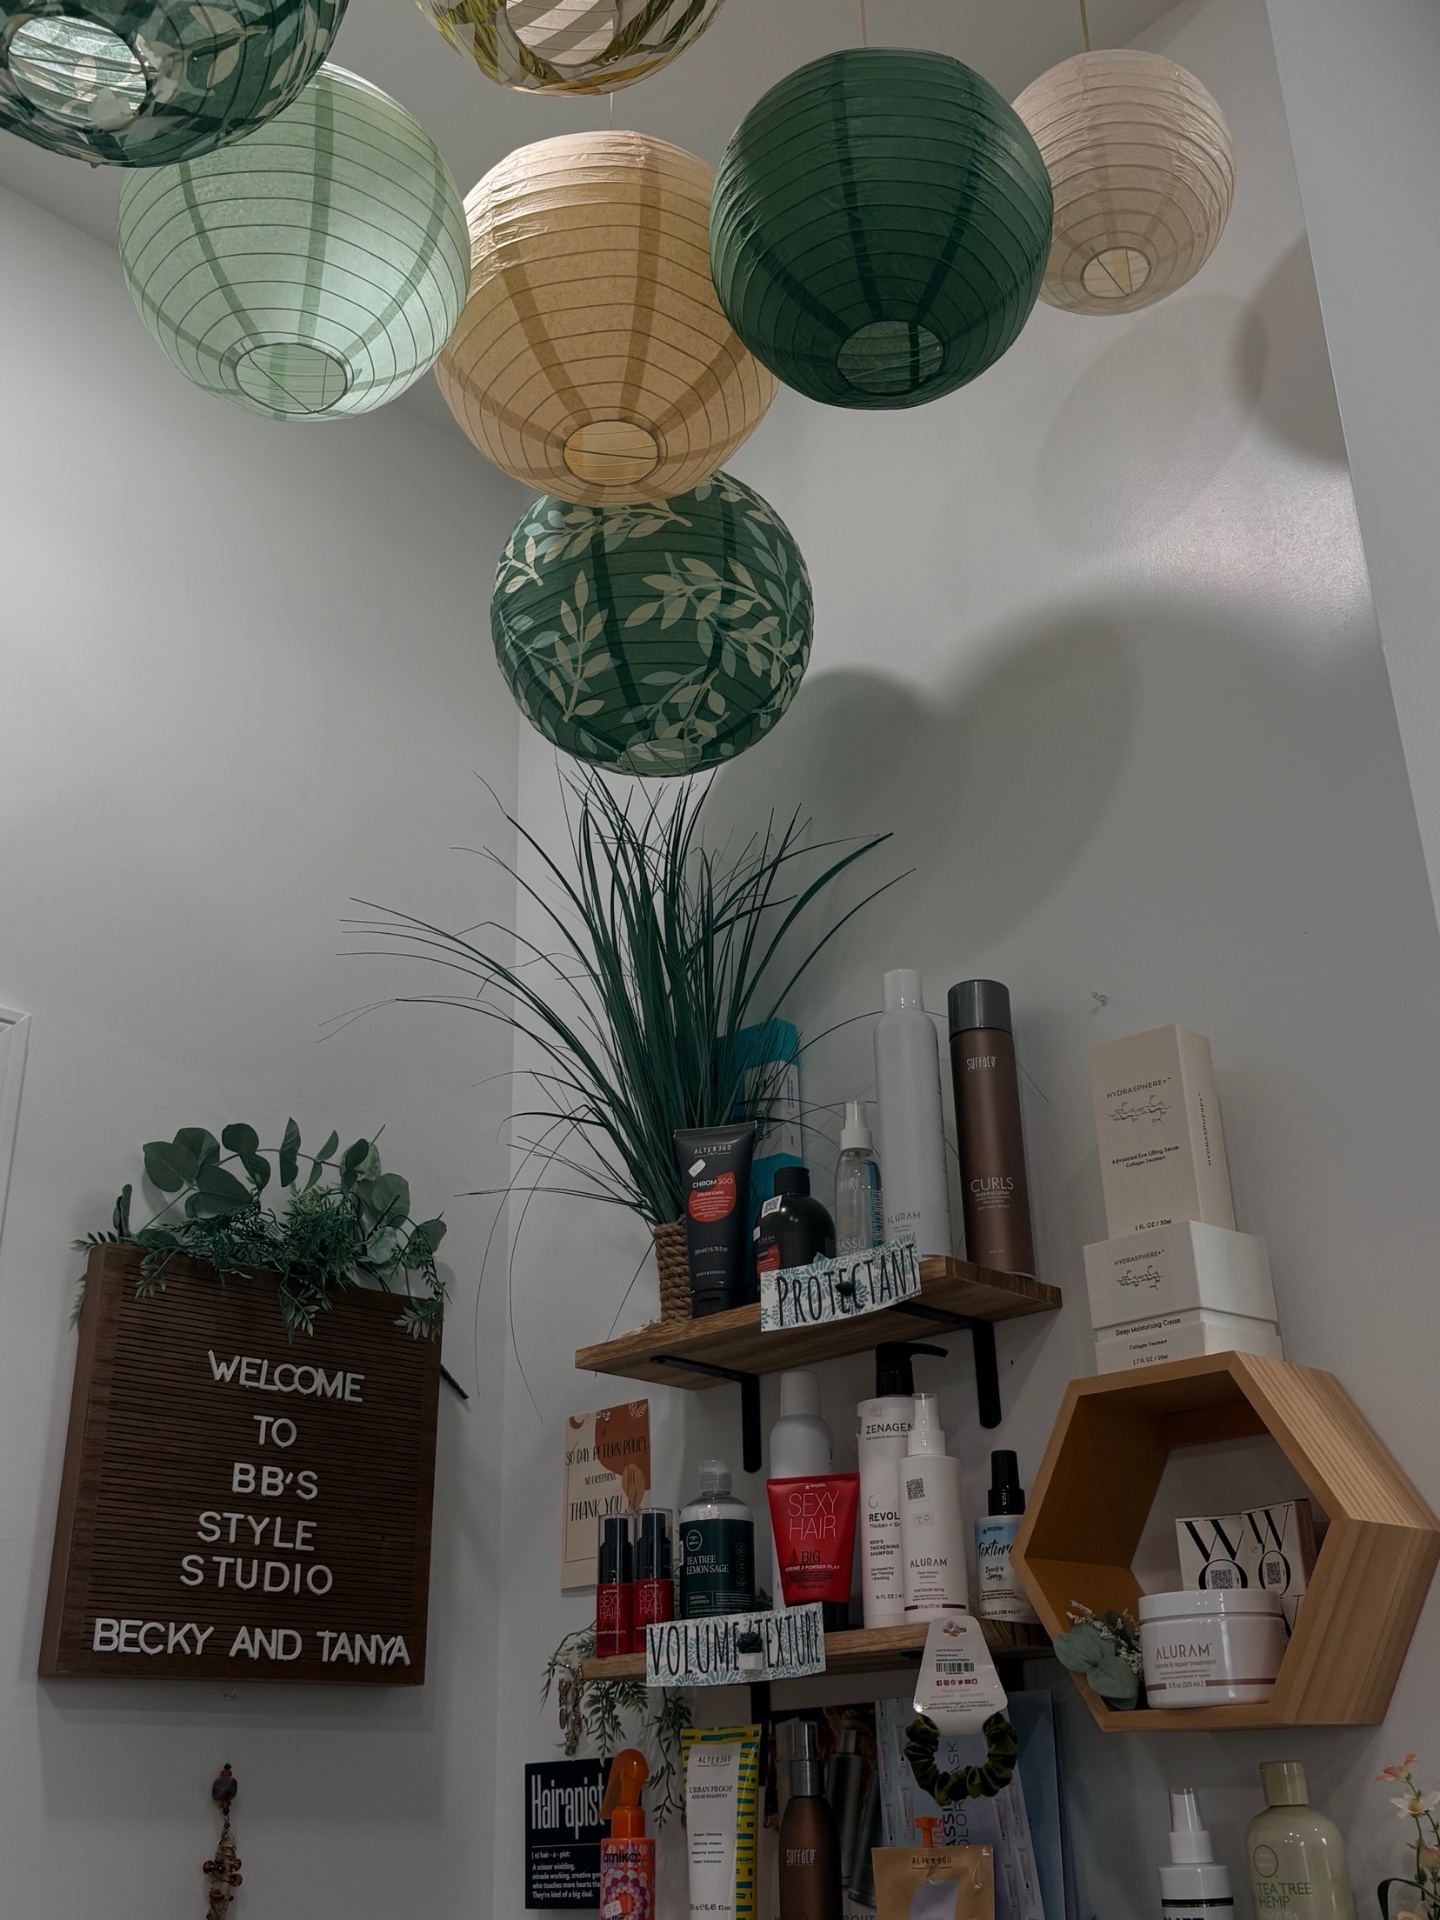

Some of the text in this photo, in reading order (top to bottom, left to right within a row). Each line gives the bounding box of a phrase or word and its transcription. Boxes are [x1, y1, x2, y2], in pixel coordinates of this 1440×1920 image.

[1148, 1148, 1164, 1156] Lifting
[1164, 1145, 1179, 1153] Serum
[970, 1176, 1014, 1193] CURLS
[776, 1242, 918, 1328] PROTECTANT
[1116, 1318, 1181, 1337] Deep Moisturizing Cream
[1129, 1342, 1148, 1350] Collagen
[207, 1349, 365, 1403] WELCOME
[253, 1414, 298, 1449] TO
[866, 1422, 913, 1435] ZENAGEN
[576, 1447, 590, 1464] DAY
[231, 1461, 319, 1501] BB'S
[570, 1494, 623, 1521] THANK YOU
[788, 1489, 840, 1517] SEXY
[869, 1511, 900, 1522] REVOL
[197, 1511, 318, 1552] STYLE
[788, 1514, 837, 1542] HAIR
[686, 1555, 717, 1566] TEA TREE
[801, 1549, 821, 1565] BIG
[910, 1557, 948, 1568] ALURAM
[179, 1553, 334, 1596] STUDIO
[686, 1563, 730, 1576] LEMON SAGE
[599, 1594, 622, 1608] SEXY
[639, 1589, 664, 1602] SEXY
[599, 1606, 621, 1619] HAIR
[91, 1617, 412, 1667] BECKY AND TANYA
[649, 1621, 740, 1678] VOLUME
[1156, 1643, 1210, 1660] ALURAM
[1189, 1659, 1217, 1667] treatment
[689, 1785, 734, 1794] URBAN PROOF
[531, 1772, 605, 1840] Hairapist
[604, 1852, 641, 1863] amika:
[537, 1863, 553, 1871] scissor
[532, 1872, 549, 1880] miracle
[571, 1870, 591, 1879] creative
[532, 1881, 543, 1889] who
[1256, 1881, 1313, 1895] TEA TREE
[532, 1891, 550, 1900] They're
[550, 1890, 562, 1898] kind
[572, 1890, 581, 1899] big
[581, 1889, 594, 1898] deal.
[1258, 1895, 1290, 1908] HEMP
